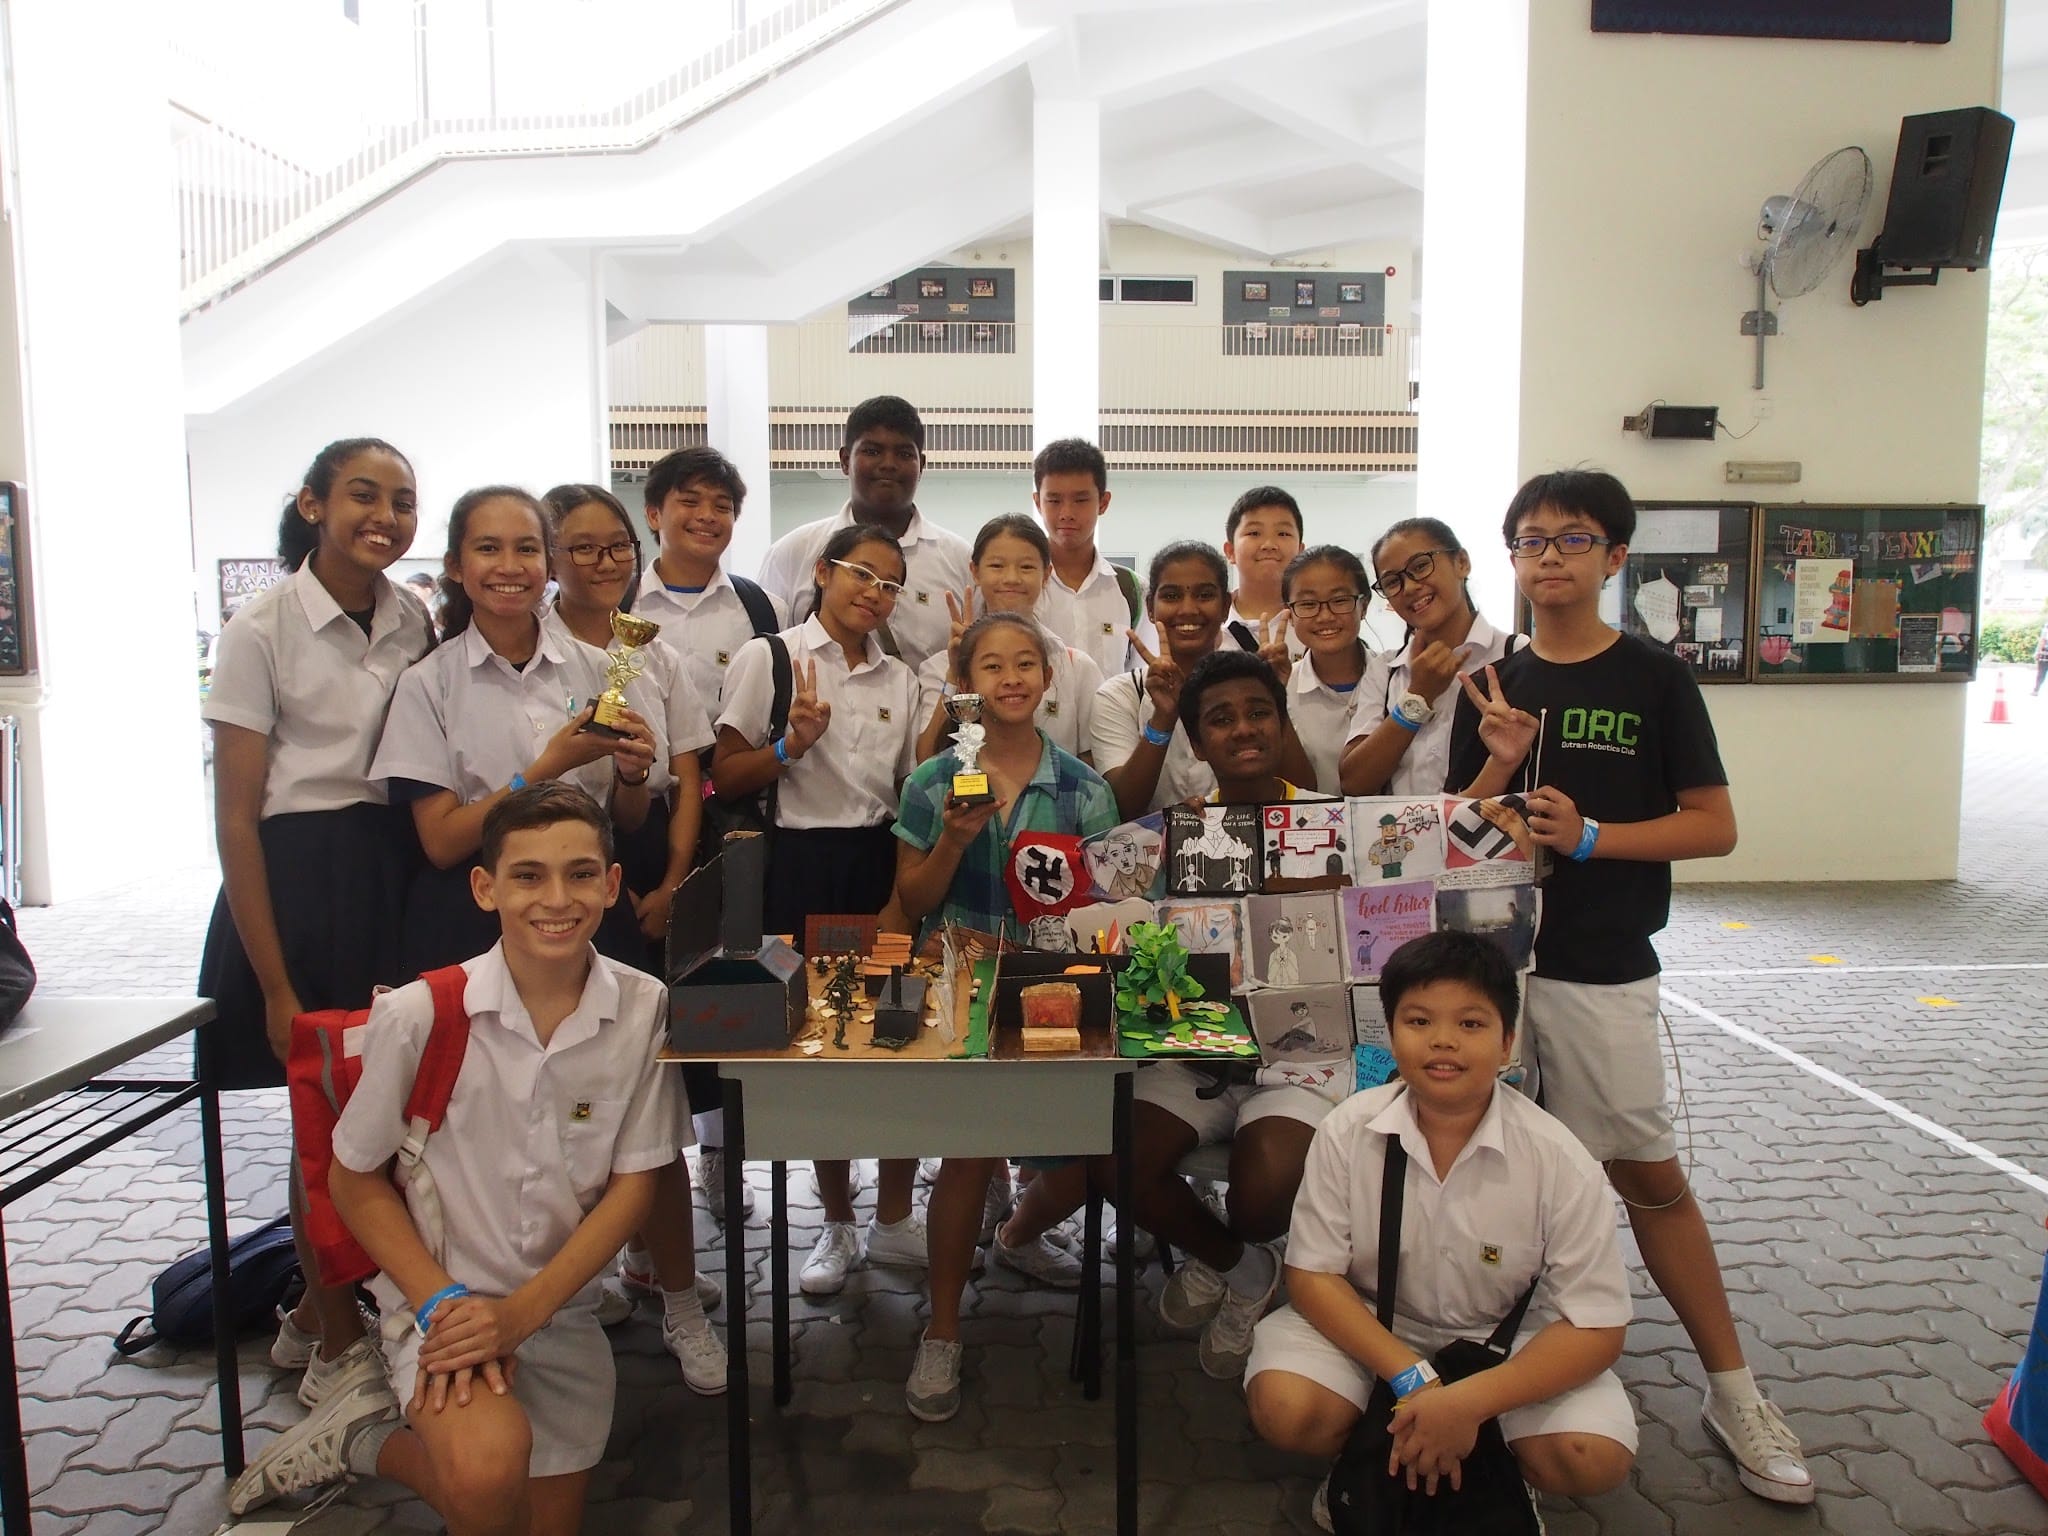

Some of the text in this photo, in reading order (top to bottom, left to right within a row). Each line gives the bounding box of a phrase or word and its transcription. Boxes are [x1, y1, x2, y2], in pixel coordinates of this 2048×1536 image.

[1562, 708, 1641, 745] ORC
[1561, 741, 1636, 756] Outram Robotics Club
